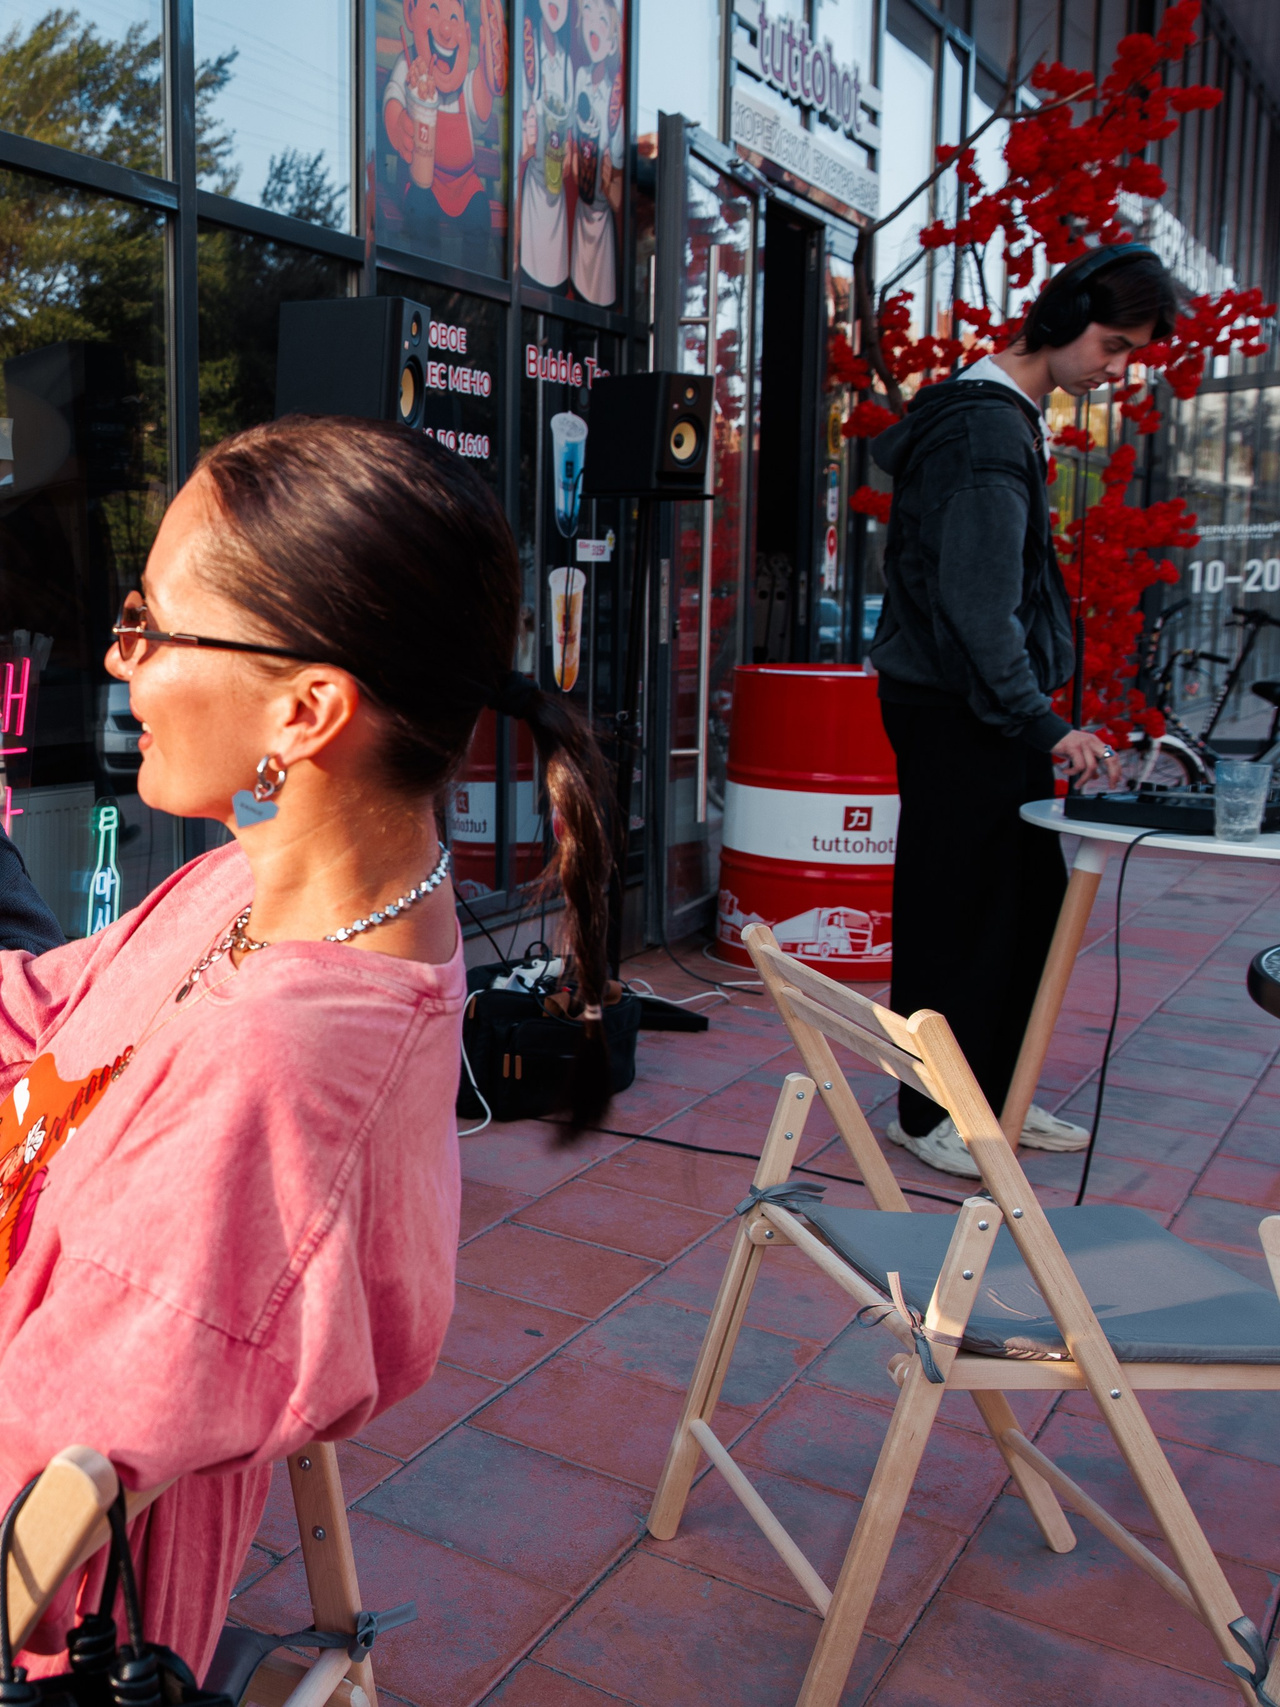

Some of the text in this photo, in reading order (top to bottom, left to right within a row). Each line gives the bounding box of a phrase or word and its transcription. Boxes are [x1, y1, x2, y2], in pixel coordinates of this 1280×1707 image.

[757, 1, 863, 134] tuttohot
[449, 364, 492, 398] МЕНЮ
[525, 344, 583, 388] Bubble
[458, 432, 490, 459] 16:00
[811, 835, 896, 854] tuttohot
